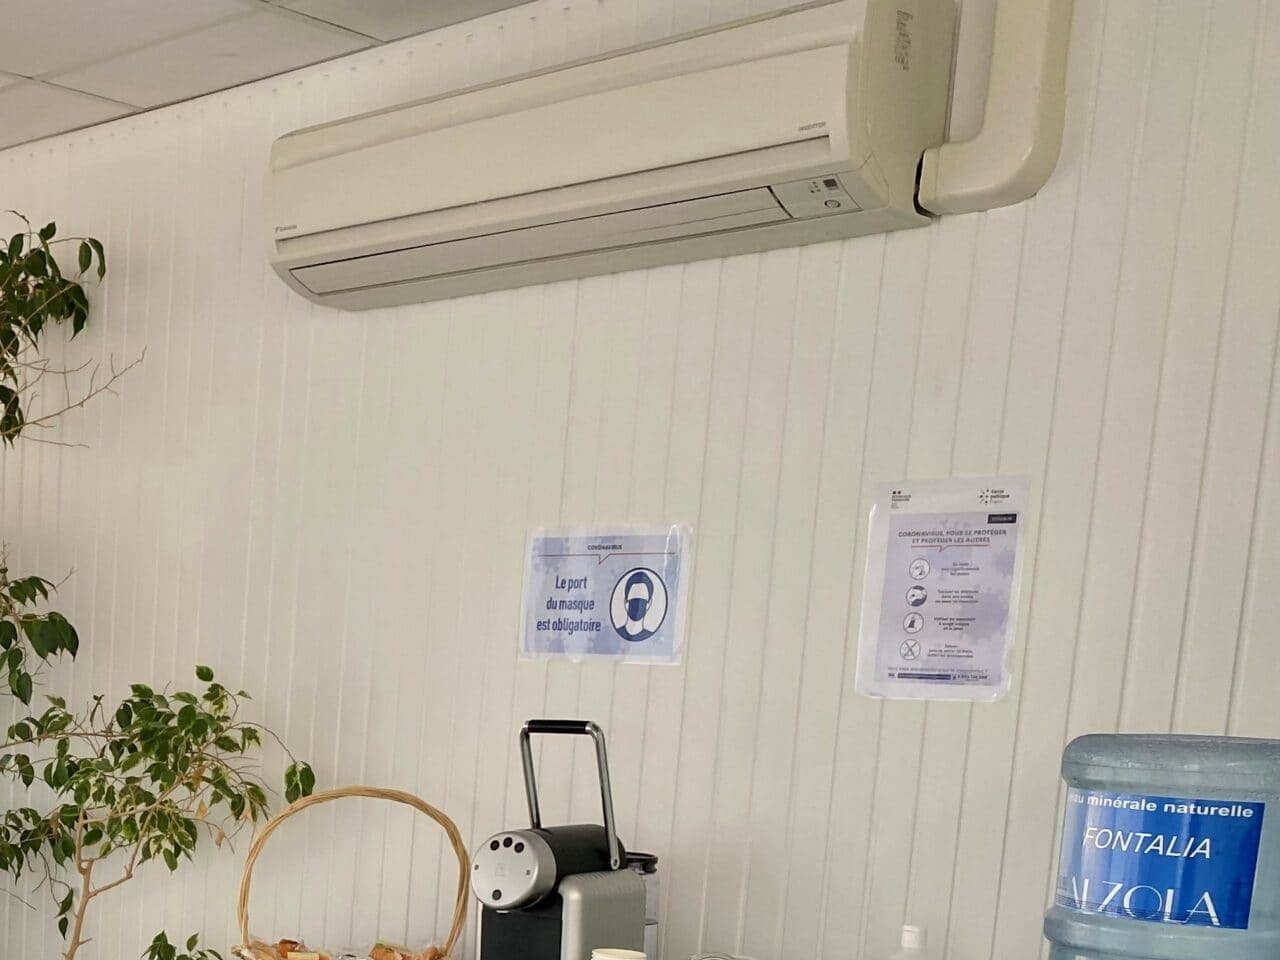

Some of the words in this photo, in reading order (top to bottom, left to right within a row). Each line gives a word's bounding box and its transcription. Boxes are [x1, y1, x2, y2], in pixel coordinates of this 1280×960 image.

[555, 576, 566, 589] Le
[567, 576, 588, 592] port
[546, 597, 557, 610] du
[558, 599, 595, 614] masque
[536, 619, 551, 631] est
[552, 618, 601, 635] obligatoire
[1087, 795, 1158, 812] minérale
[1163, 802, 1254, 818] naturelle
[1082, 827, 1212, 859] FONTALIA
